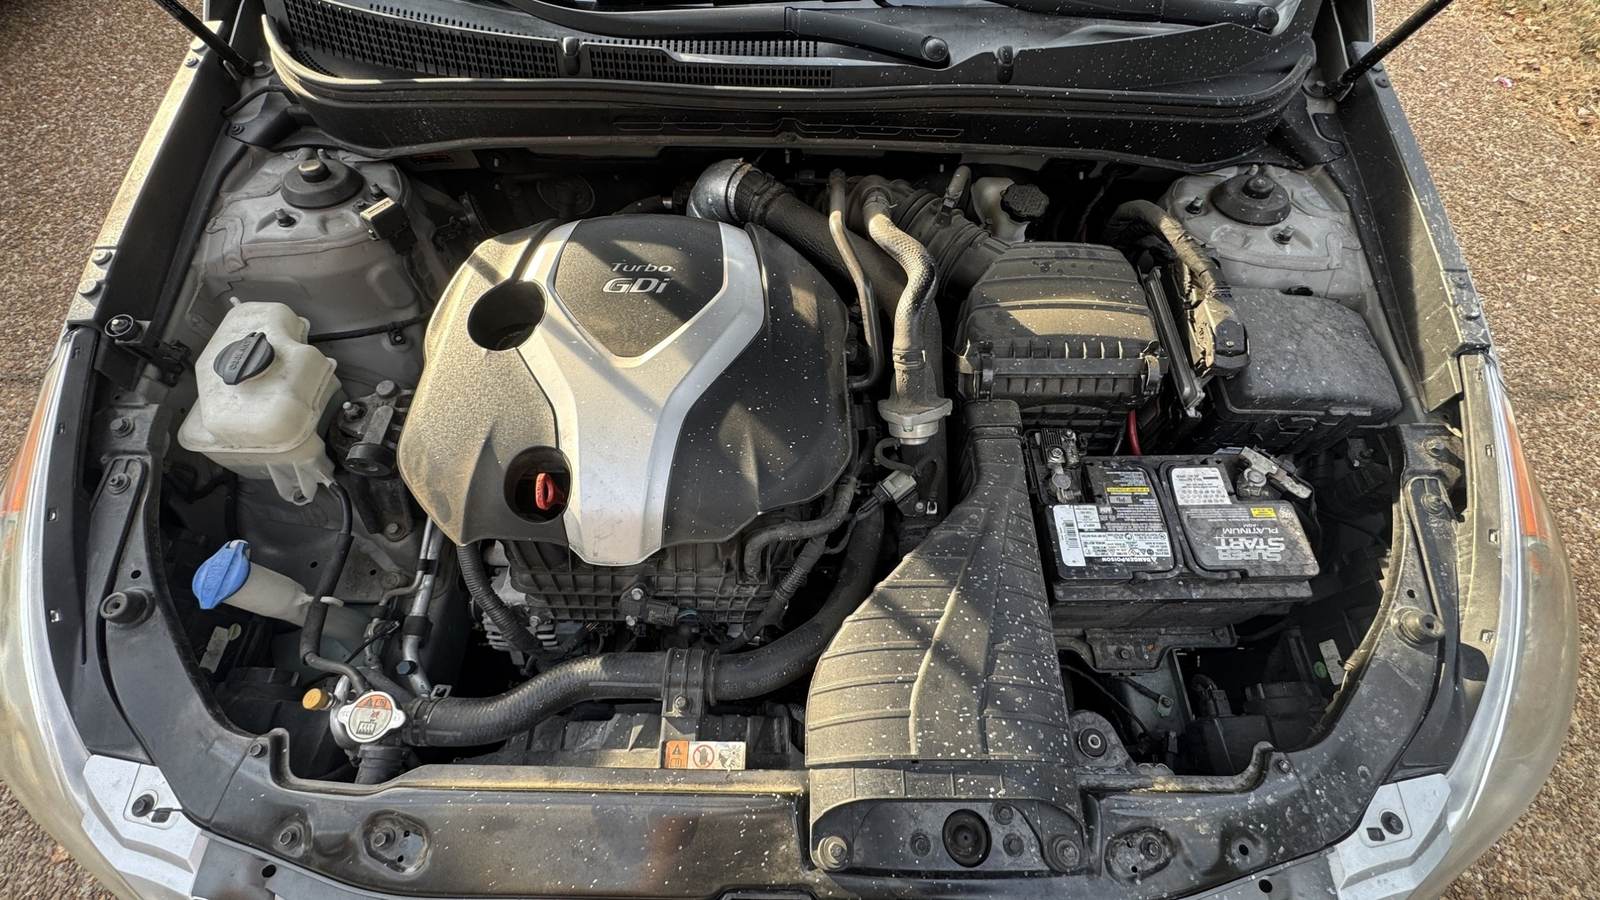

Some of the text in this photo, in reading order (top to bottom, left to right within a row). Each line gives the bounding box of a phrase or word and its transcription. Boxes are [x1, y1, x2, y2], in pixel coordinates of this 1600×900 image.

[611, 263, 674, 273] Turbo
[602, 277, 670, 294] GDi
[1222, 527, 1279, 535] PLATINUM
[1215, 537, 1286, 551] START
[1217, 549, 1282, 562] SUPER
